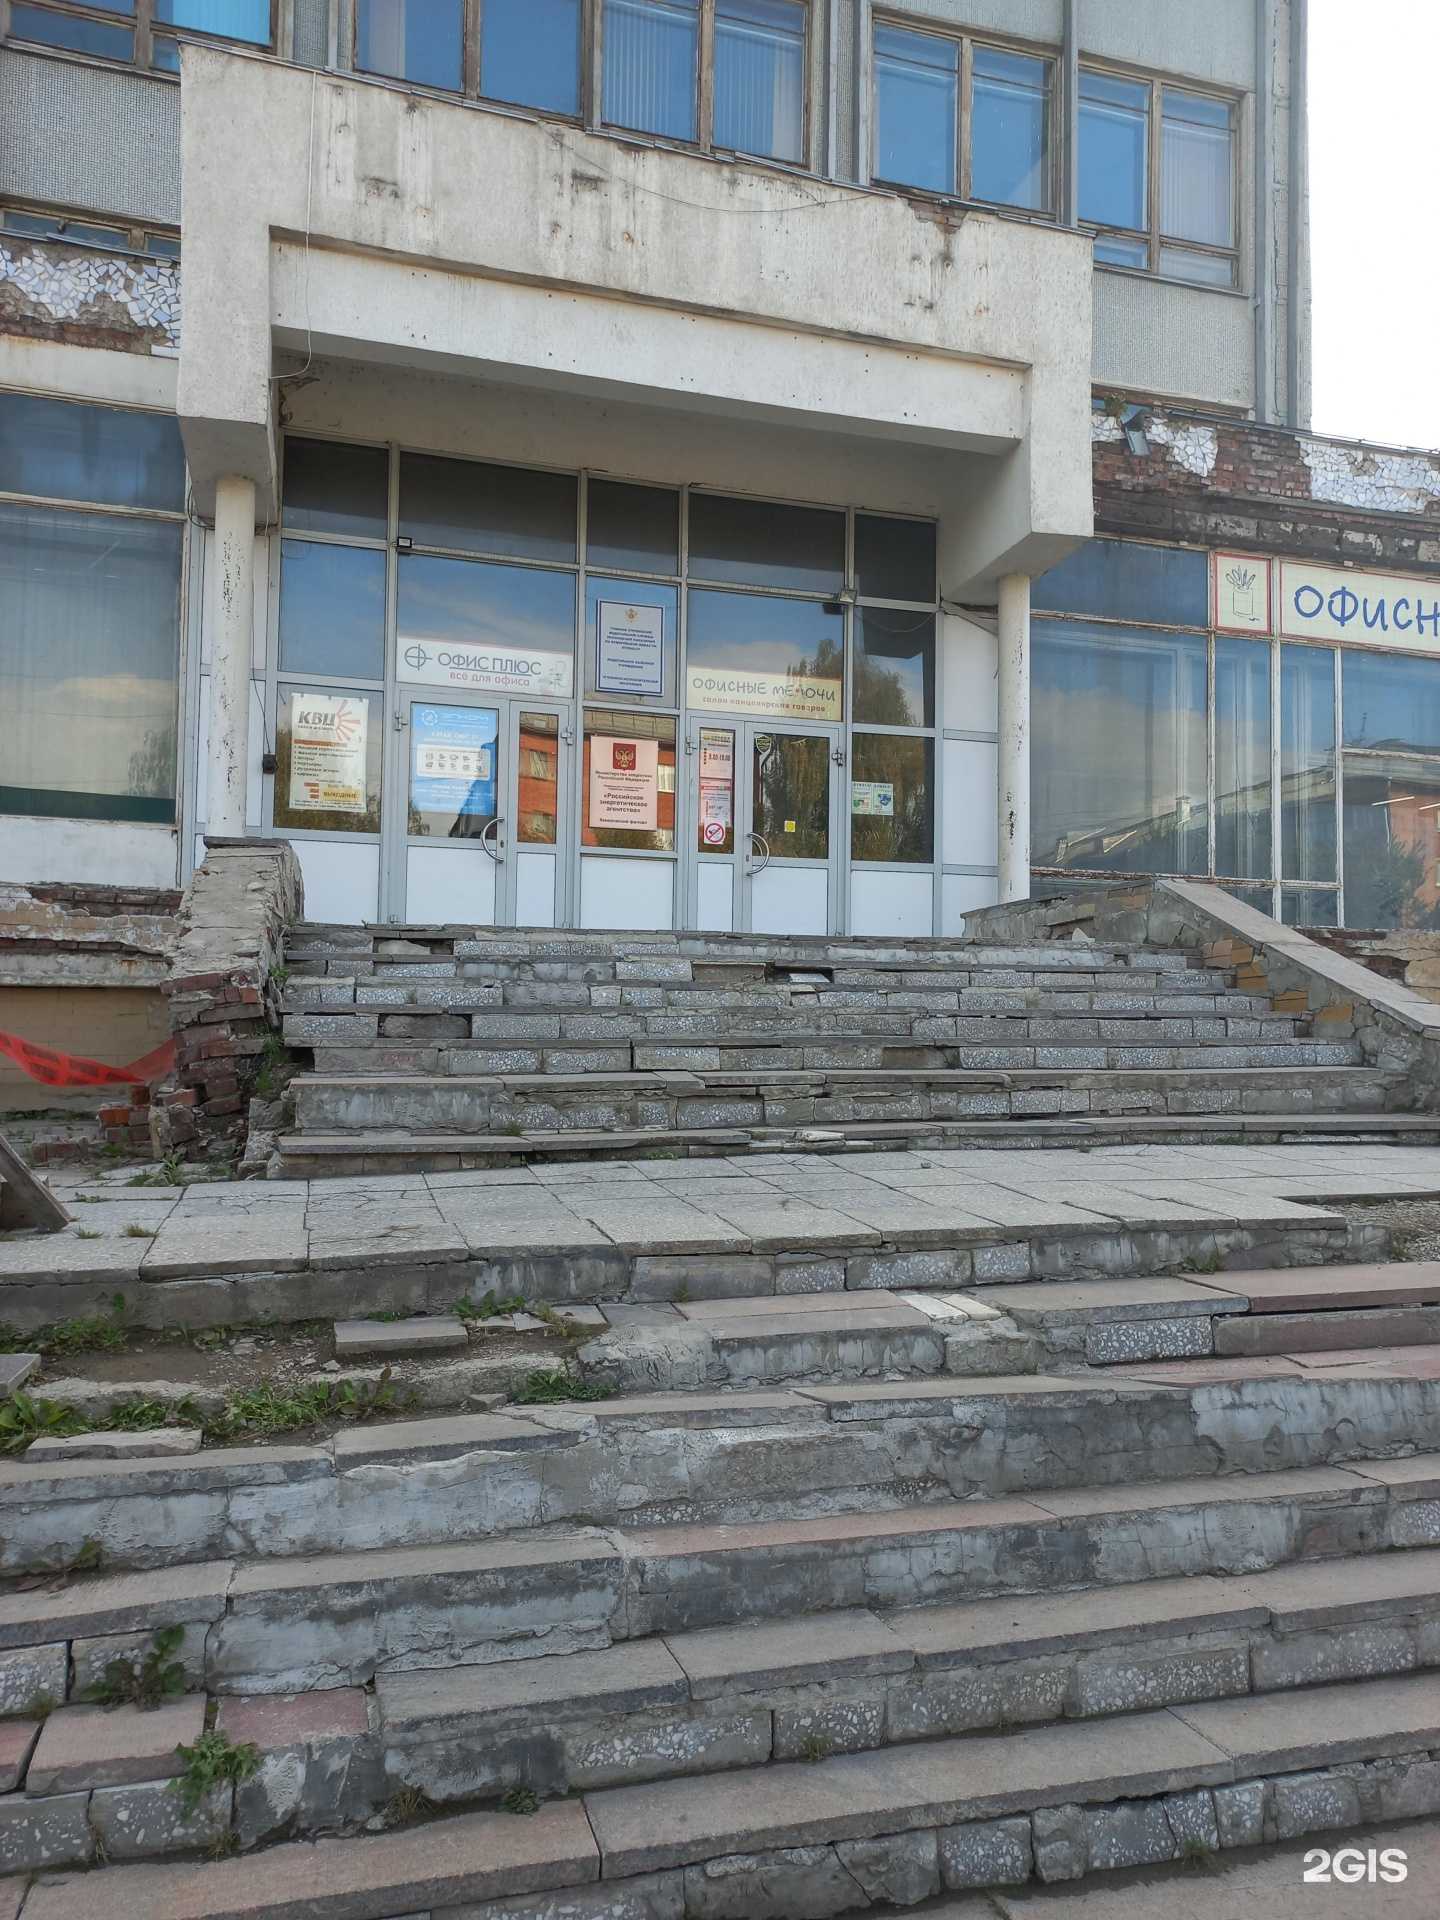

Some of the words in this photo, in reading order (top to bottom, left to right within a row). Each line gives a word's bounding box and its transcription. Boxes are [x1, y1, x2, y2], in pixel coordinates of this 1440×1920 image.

[437, 651, 489, 671] ОФИС
[492, 657, 542, 676] ПЛЮС
[471, 673, 491, 684] для
[494, 674, 530, 688] офиса
[692, 677, 768, 695] ОФИСНЫЕ
